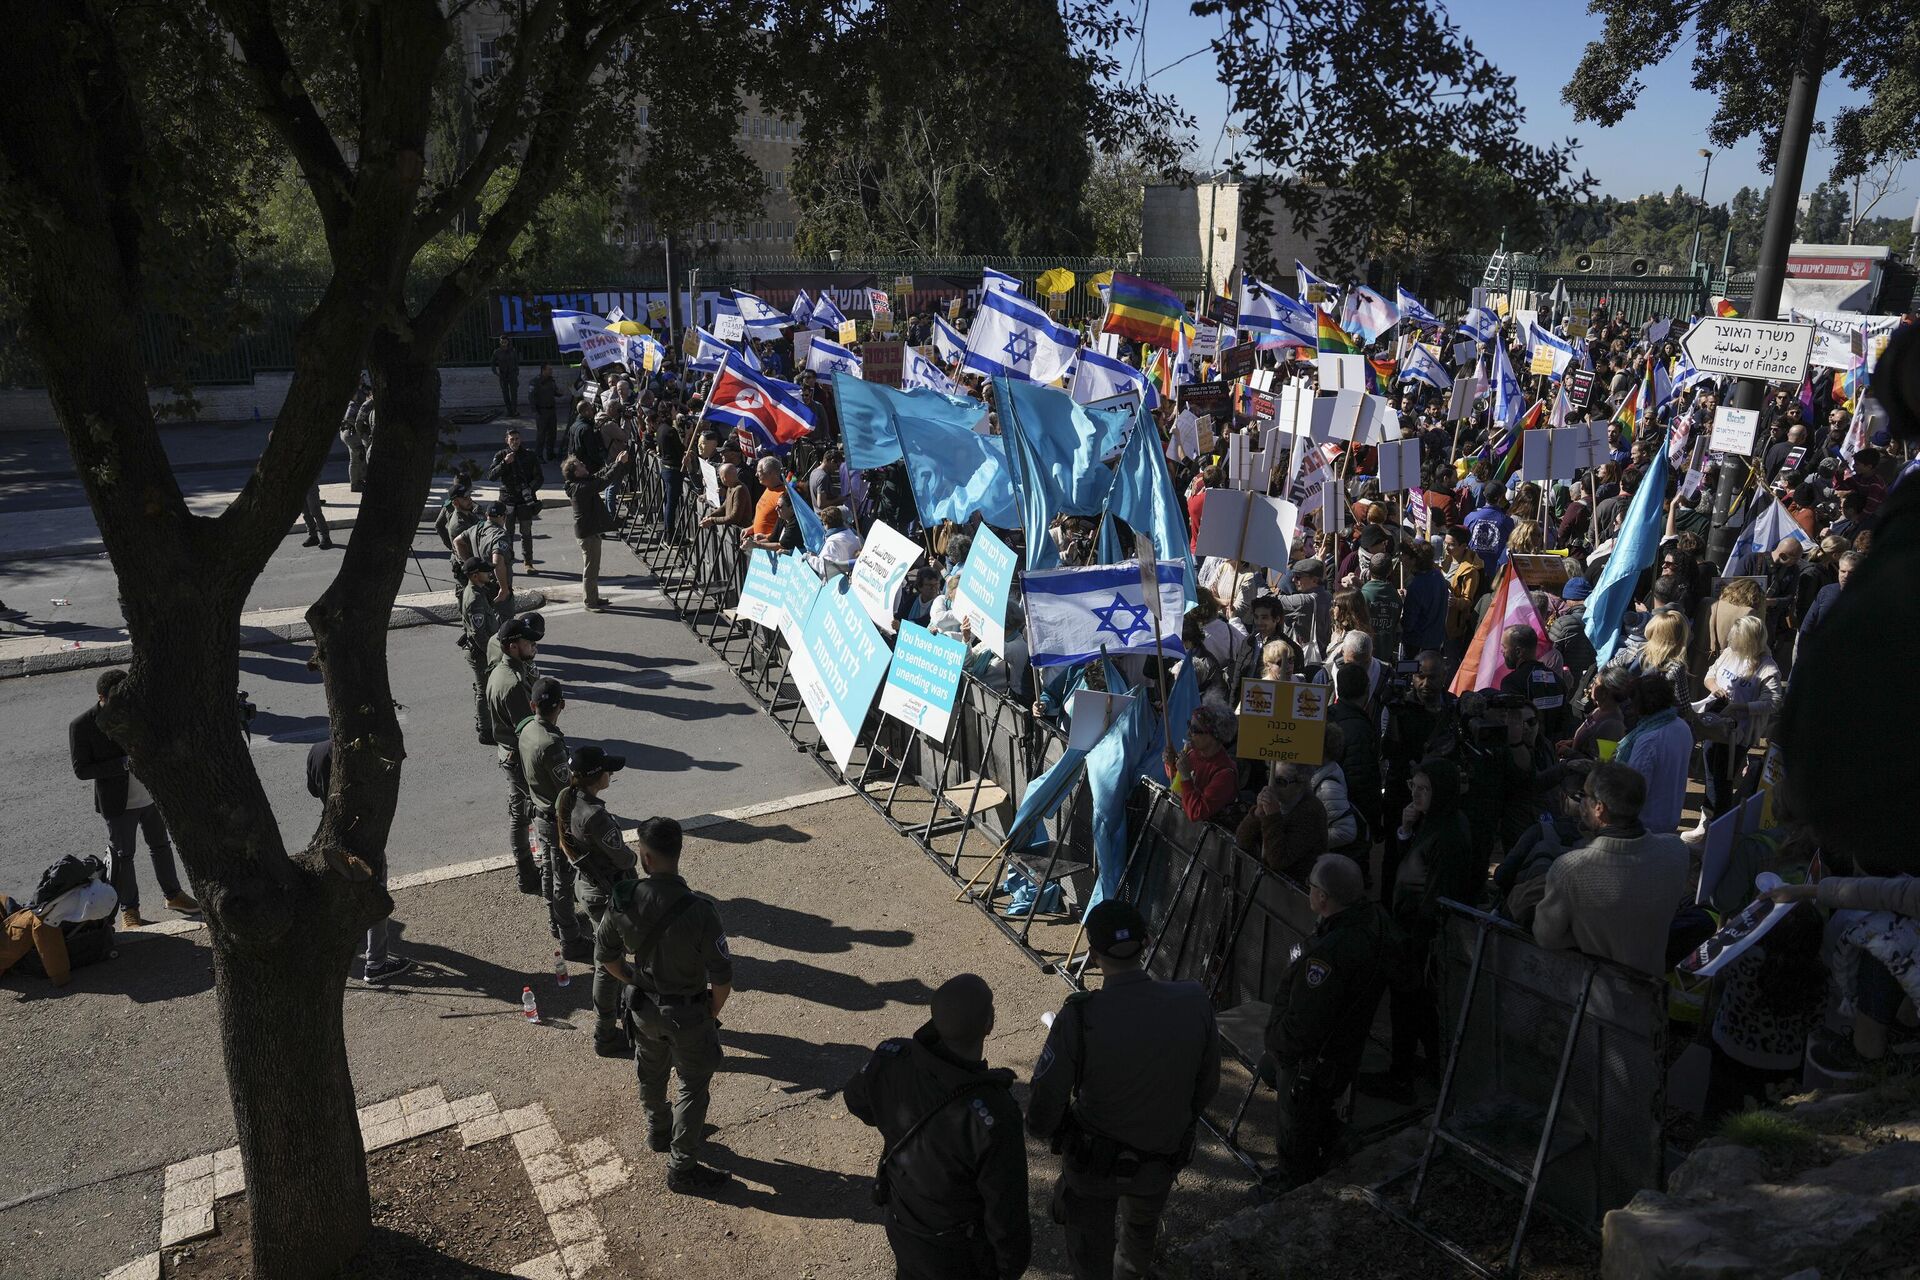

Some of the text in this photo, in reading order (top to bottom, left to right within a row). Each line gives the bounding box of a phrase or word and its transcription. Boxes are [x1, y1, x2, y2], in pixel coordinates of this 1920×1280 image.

[1715, 326, 1795, 343] משרד האוצר
[1820, 319, 1855, 334] GBT
[1714, 341, 1788, 361] وزارة المالية
[1701, 354, 1797, 374] Ministry of Finance
[882, 551, 896, 566] נשים
[988, 545, 1000, 562] לכם
[997, 556, 1009, 570] אין
[845, 608, 863, 639] לכם
[823, 610, 861, 678] לדון אותנו
[858, 632, 876, 662] אין
[900, 628, 962, 666] You have no right
[814, 636, 848, 702] למלחמות
[896, 648, 956, 684] to sentence us to
[895, 666, 949, 699] unending wars
[1267, 720, 1296, 731] סכנה
[1268, 734, 1294, 746] خطر
[1259, 747, 1300, 761] Danger
